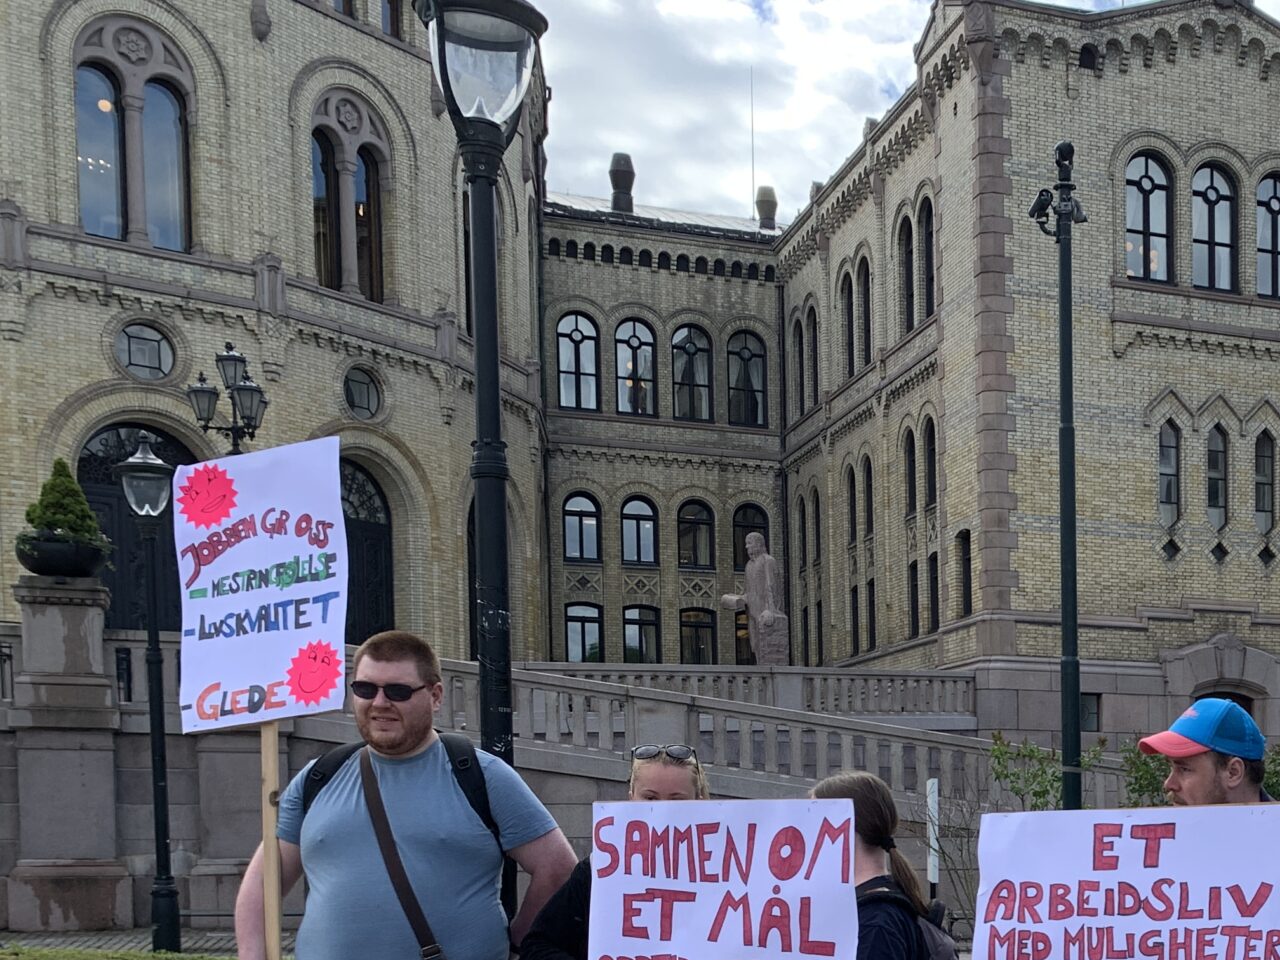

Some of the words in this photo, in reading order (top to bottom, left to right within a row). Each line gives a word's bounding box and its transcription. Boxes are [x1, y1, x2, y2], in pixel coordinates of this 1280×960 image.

[181, 514, 257, 589] JOBBEN
[295, 513, 334, 549] OSS
[594, 815, 757, 886] SAMMEN
[768, 816, 851, 883] OM
[1092, 822, 1176, 871] ET
[622, 888, 697, 941] ET
[707, 885, 836, 956] MÅL
[984, 878, 1274, 924] ARBEIDSLIV
